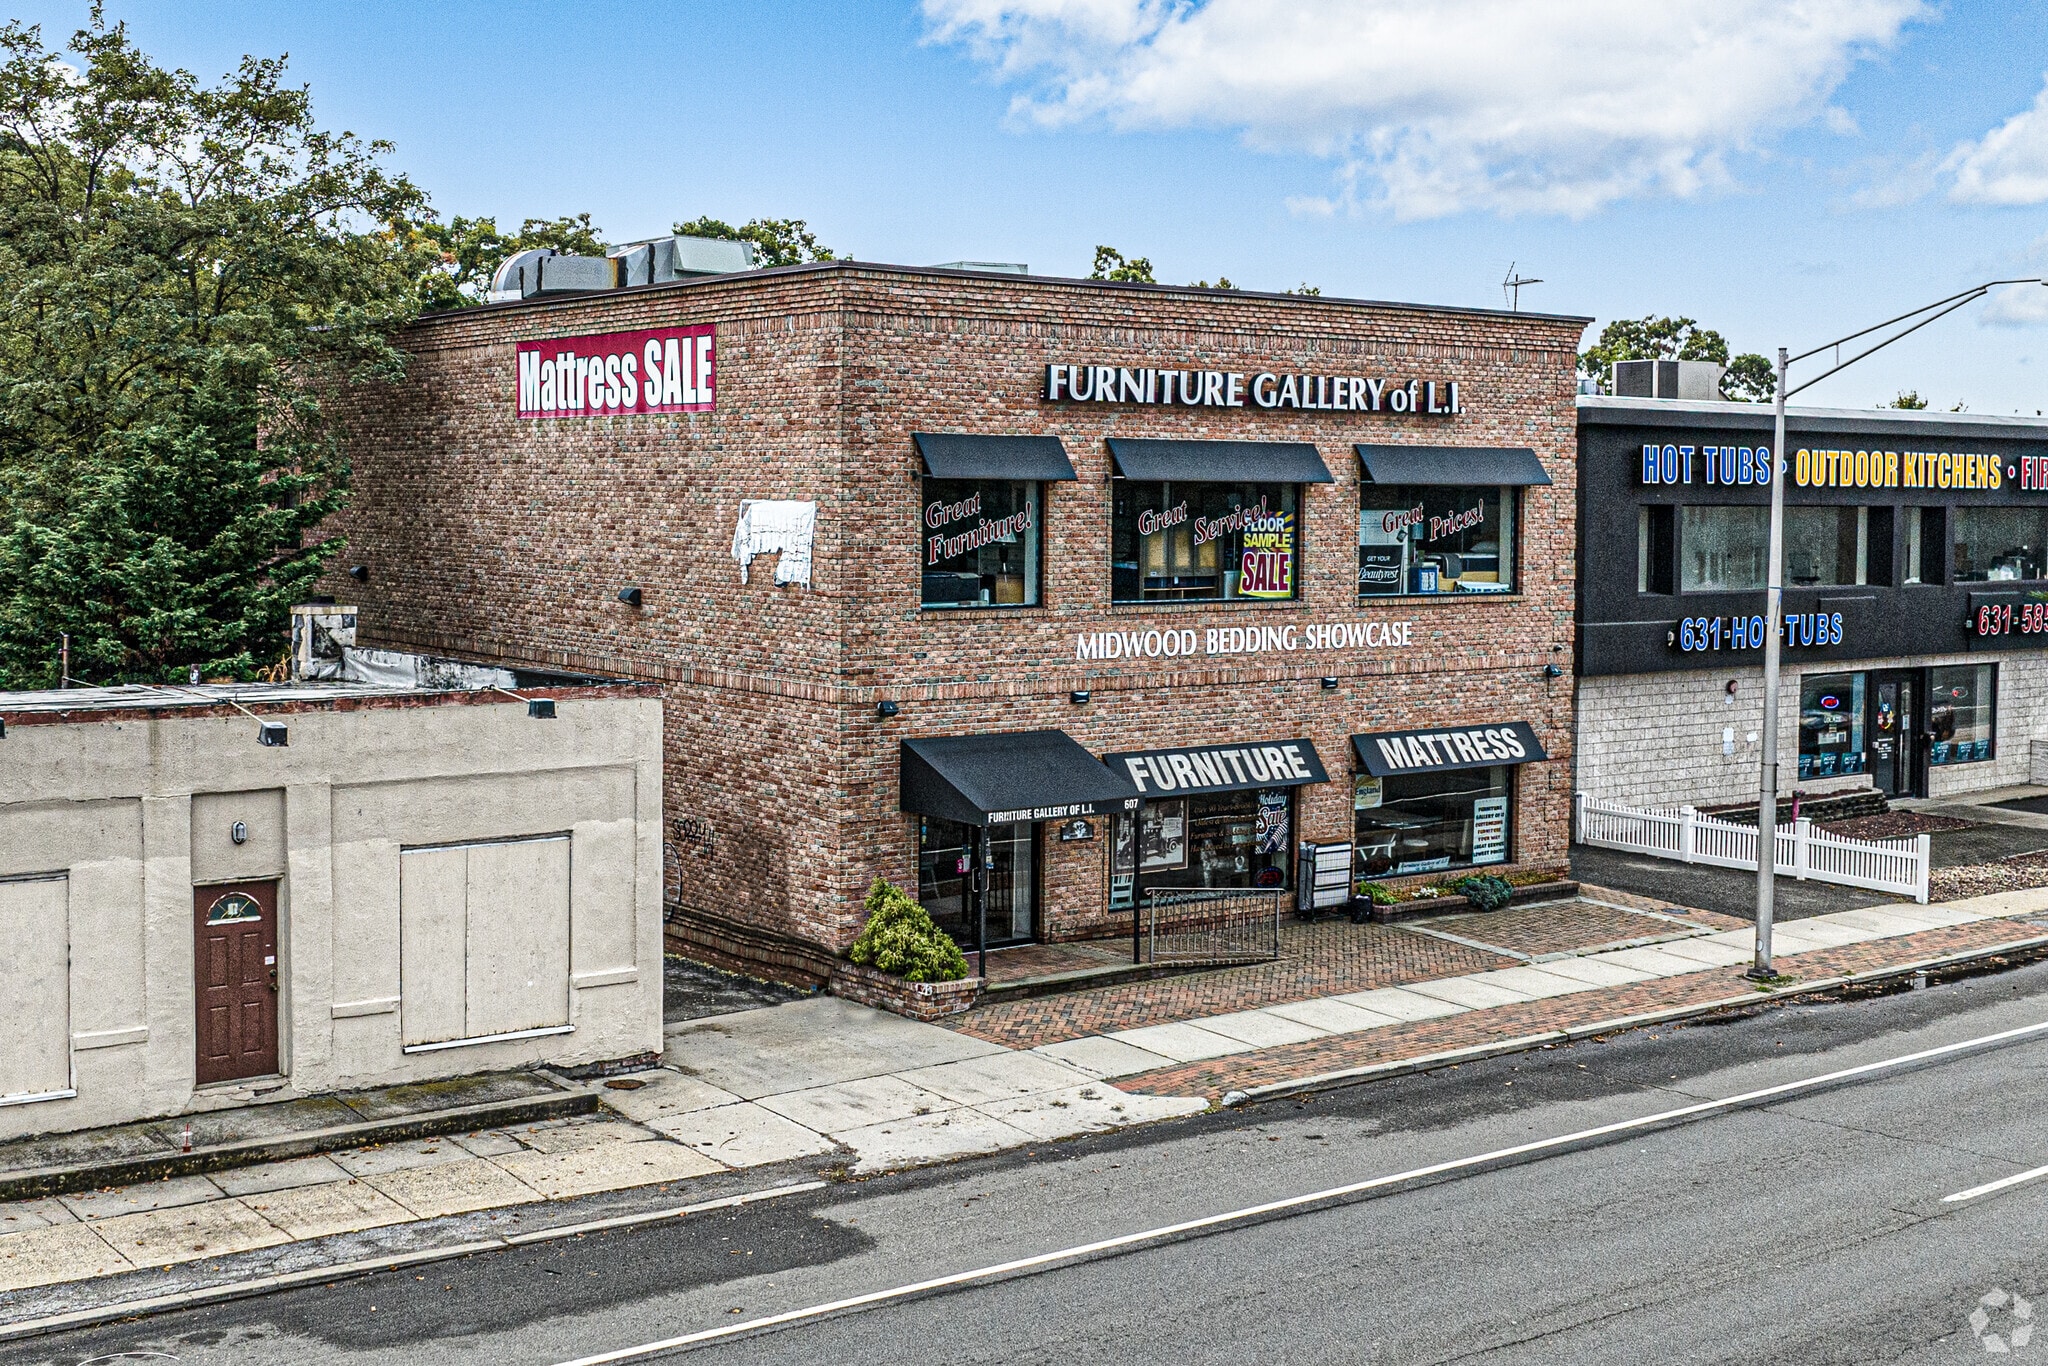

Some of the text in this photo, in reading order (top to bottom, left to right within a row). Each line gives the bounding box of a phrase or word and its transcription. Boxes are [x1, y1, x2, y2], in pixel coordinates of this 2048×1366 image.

[518, 335, 713, 412] Mattress SALE
[1049, 364, 1467, 415] FURNITURE GALLERY of L.I.
[1642, 443, 1695, 485] HOT
[1702, 445, 1771, 486] TUBS
[1795, 448, 1898, 488] OUTDOOR
[1902, 450, 2002, 490] KITCHENS
[925, 491, 981, 529] Great
[1138, 494, 1267, 546] Great Service!
[1244, 515, 1285, 532] FLOOR
[1382, 498, 1484, 542] Great Prices!
[927, 500, 1032, 566] Furniture!
[1243, 532, 1291, 548] SAMPLE
[1241, 551, 1291, 593] SALE
[1075, 621, 1413, 661] MIDWOOD BEDDING SHOWCASE
[1680, 612, 1843, 651] 631-HO-TUBS
[1124, 744, 1313, 793] FURNITURE
[1376, 727, 1527, 771] MATTRESS
[988, 803, 1095, 824] FURNITURE GALLERY OF L.I.
[1124, 798, 1139, 810] 607
[1258, 791, 1287, 806] Holiday
[1256, 806, 1288, 835] Sale
